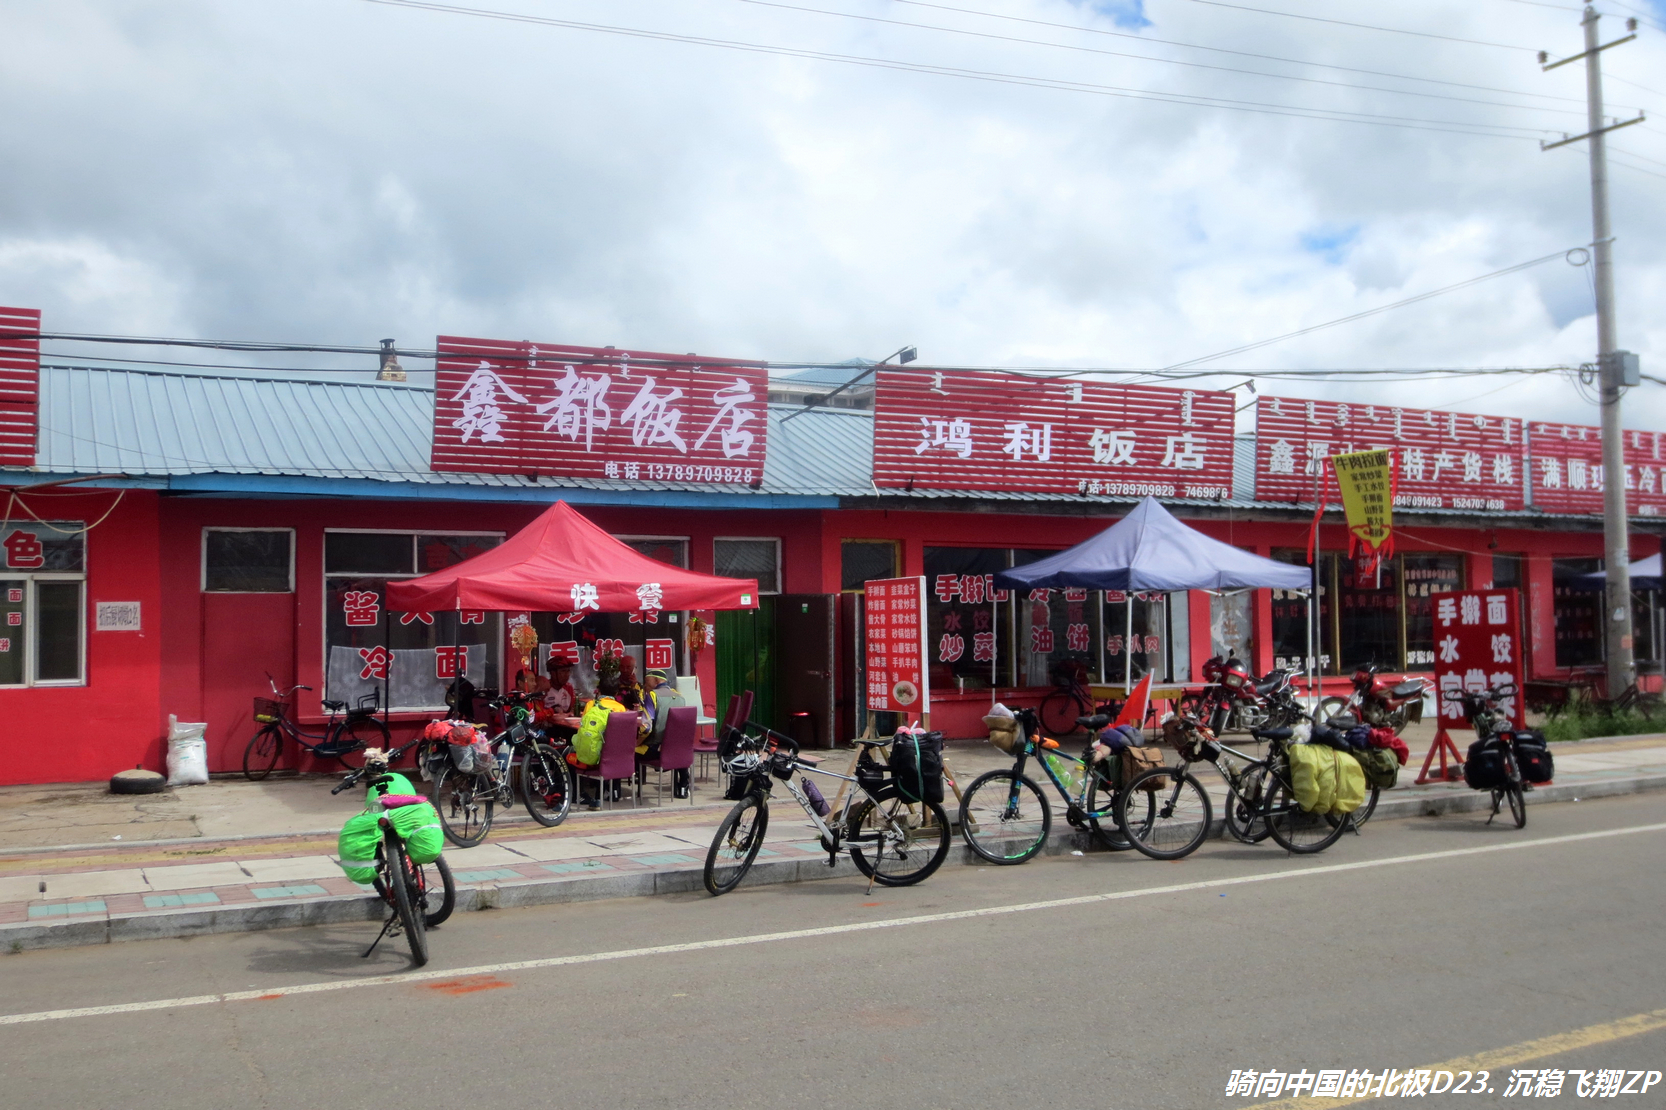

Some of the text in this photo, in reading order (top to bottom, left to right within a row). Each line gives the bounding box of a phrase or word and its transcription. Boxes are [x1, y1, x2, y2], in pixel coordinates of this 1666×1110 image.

[450, 361, 756, 459] 鑫都饭店
[914, 417, 1208, 470] 鸿利饭店
[1269, 439, 1514, 485] 鑫源特产货栈
[1335, 451, 1388, 470] 牛肉拉面
[604, 461, 753, 484] 电话 13789709828
[3, 529, 45, 568] 色
[8, 589, 23, 602] 面
[571, 582, 664, 611] 快餐
[891, 583, 916, 596] 韭菜盒子
[867, 598, 917, 611] 炸酱面 家常炒菜
[1437, 595, 1507, 627] 手擀面
[7, 612, 22, 626] 面
[867, 613, 917, 625] 酱大骨 家常水饺
[868, 628, 887, 639] 农家菜
[1031, 623, 1089, 653] 油饼
[868, 642, 887, 654] 本地鱼
[939, 632, 997, 662] 炒菜
[1439, 633, 1512, 663] 水饺
[358, 645, 468, 680] 冷面
[868, 657, 918, 669] 山野菜 手扒羊肉
[868, 683, 888, 695] 羊肉面
[868, 696, 888, 709] 牛肉面
